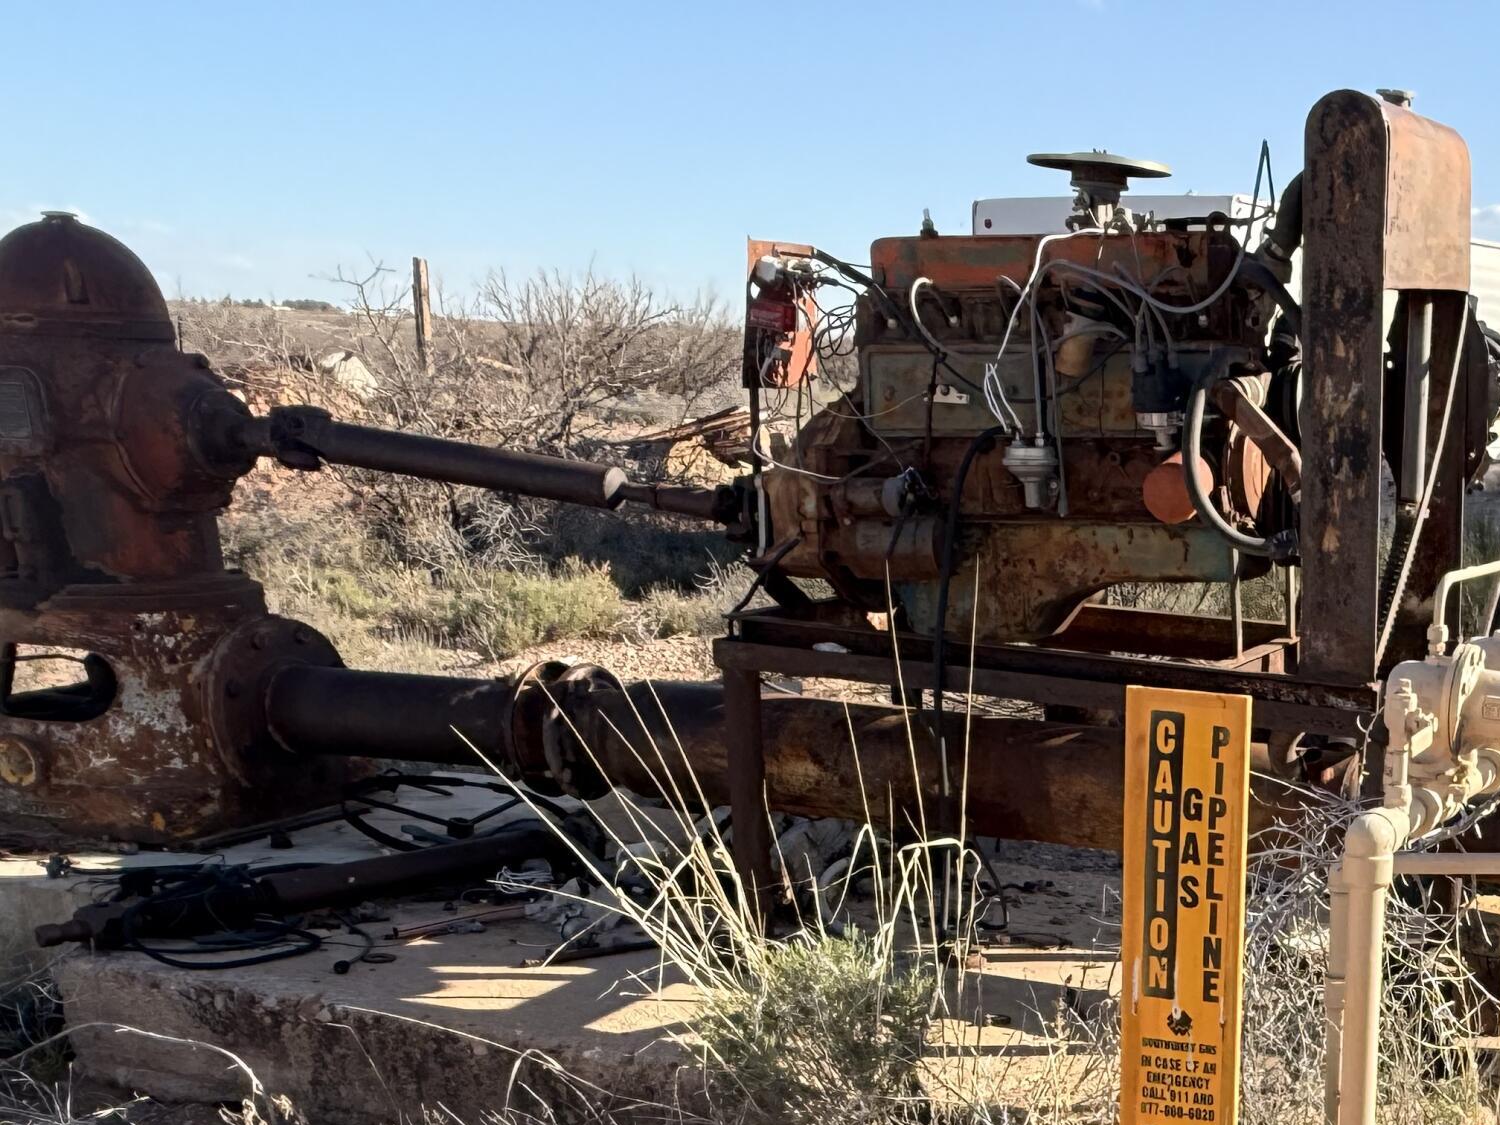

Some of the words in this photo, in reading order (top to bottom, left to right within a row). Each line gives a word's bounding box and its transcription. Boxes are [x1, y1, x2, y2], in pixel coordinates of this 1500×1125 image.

[1148, 719, 1176, 990] CAUTION
[1180, 787, 1204, 909] GAS
[1202, 725, 1231, 1003] PIPELINE
[1142, 1086, 1167, 1101] CALL
[1170, 1090, 1189, 1103] 911
[1193, 1092, 1214, 1106] AND
[1155, 1056, 1182, 1071] CASE
